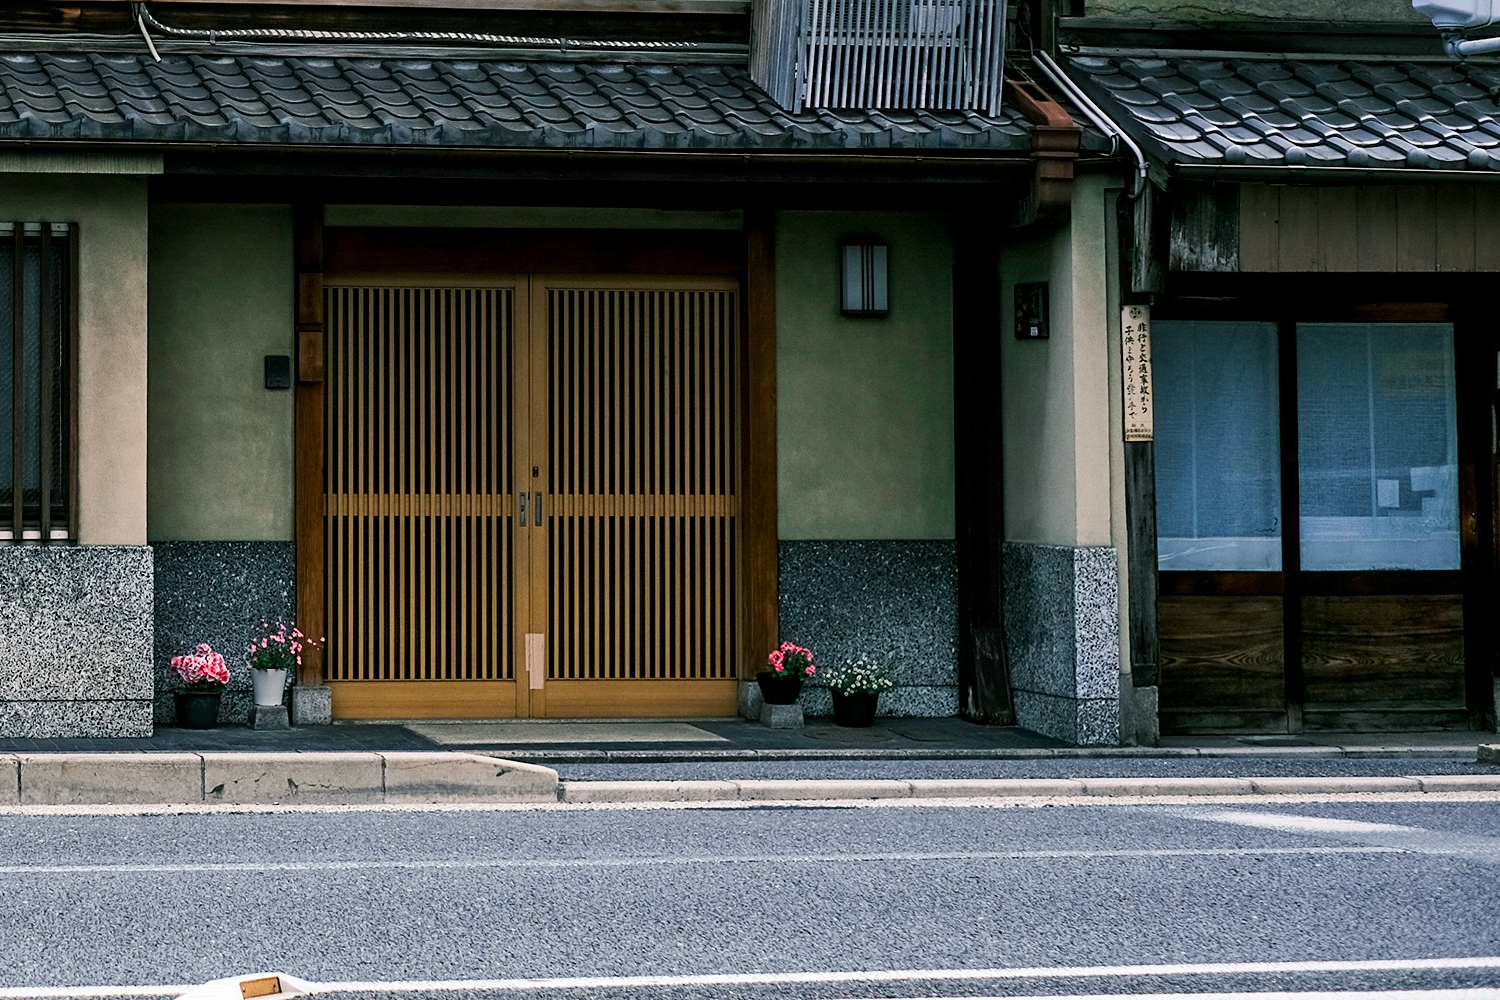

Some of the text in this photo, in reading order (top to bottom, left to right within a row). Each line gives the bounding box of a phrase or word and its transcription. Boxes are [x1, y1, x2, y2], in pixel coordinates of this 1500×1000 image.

[1124, 325, 1137, 420] 子供を守ろう愛手で
[1137, 321, 1150, 414] 非行と交通事故から
